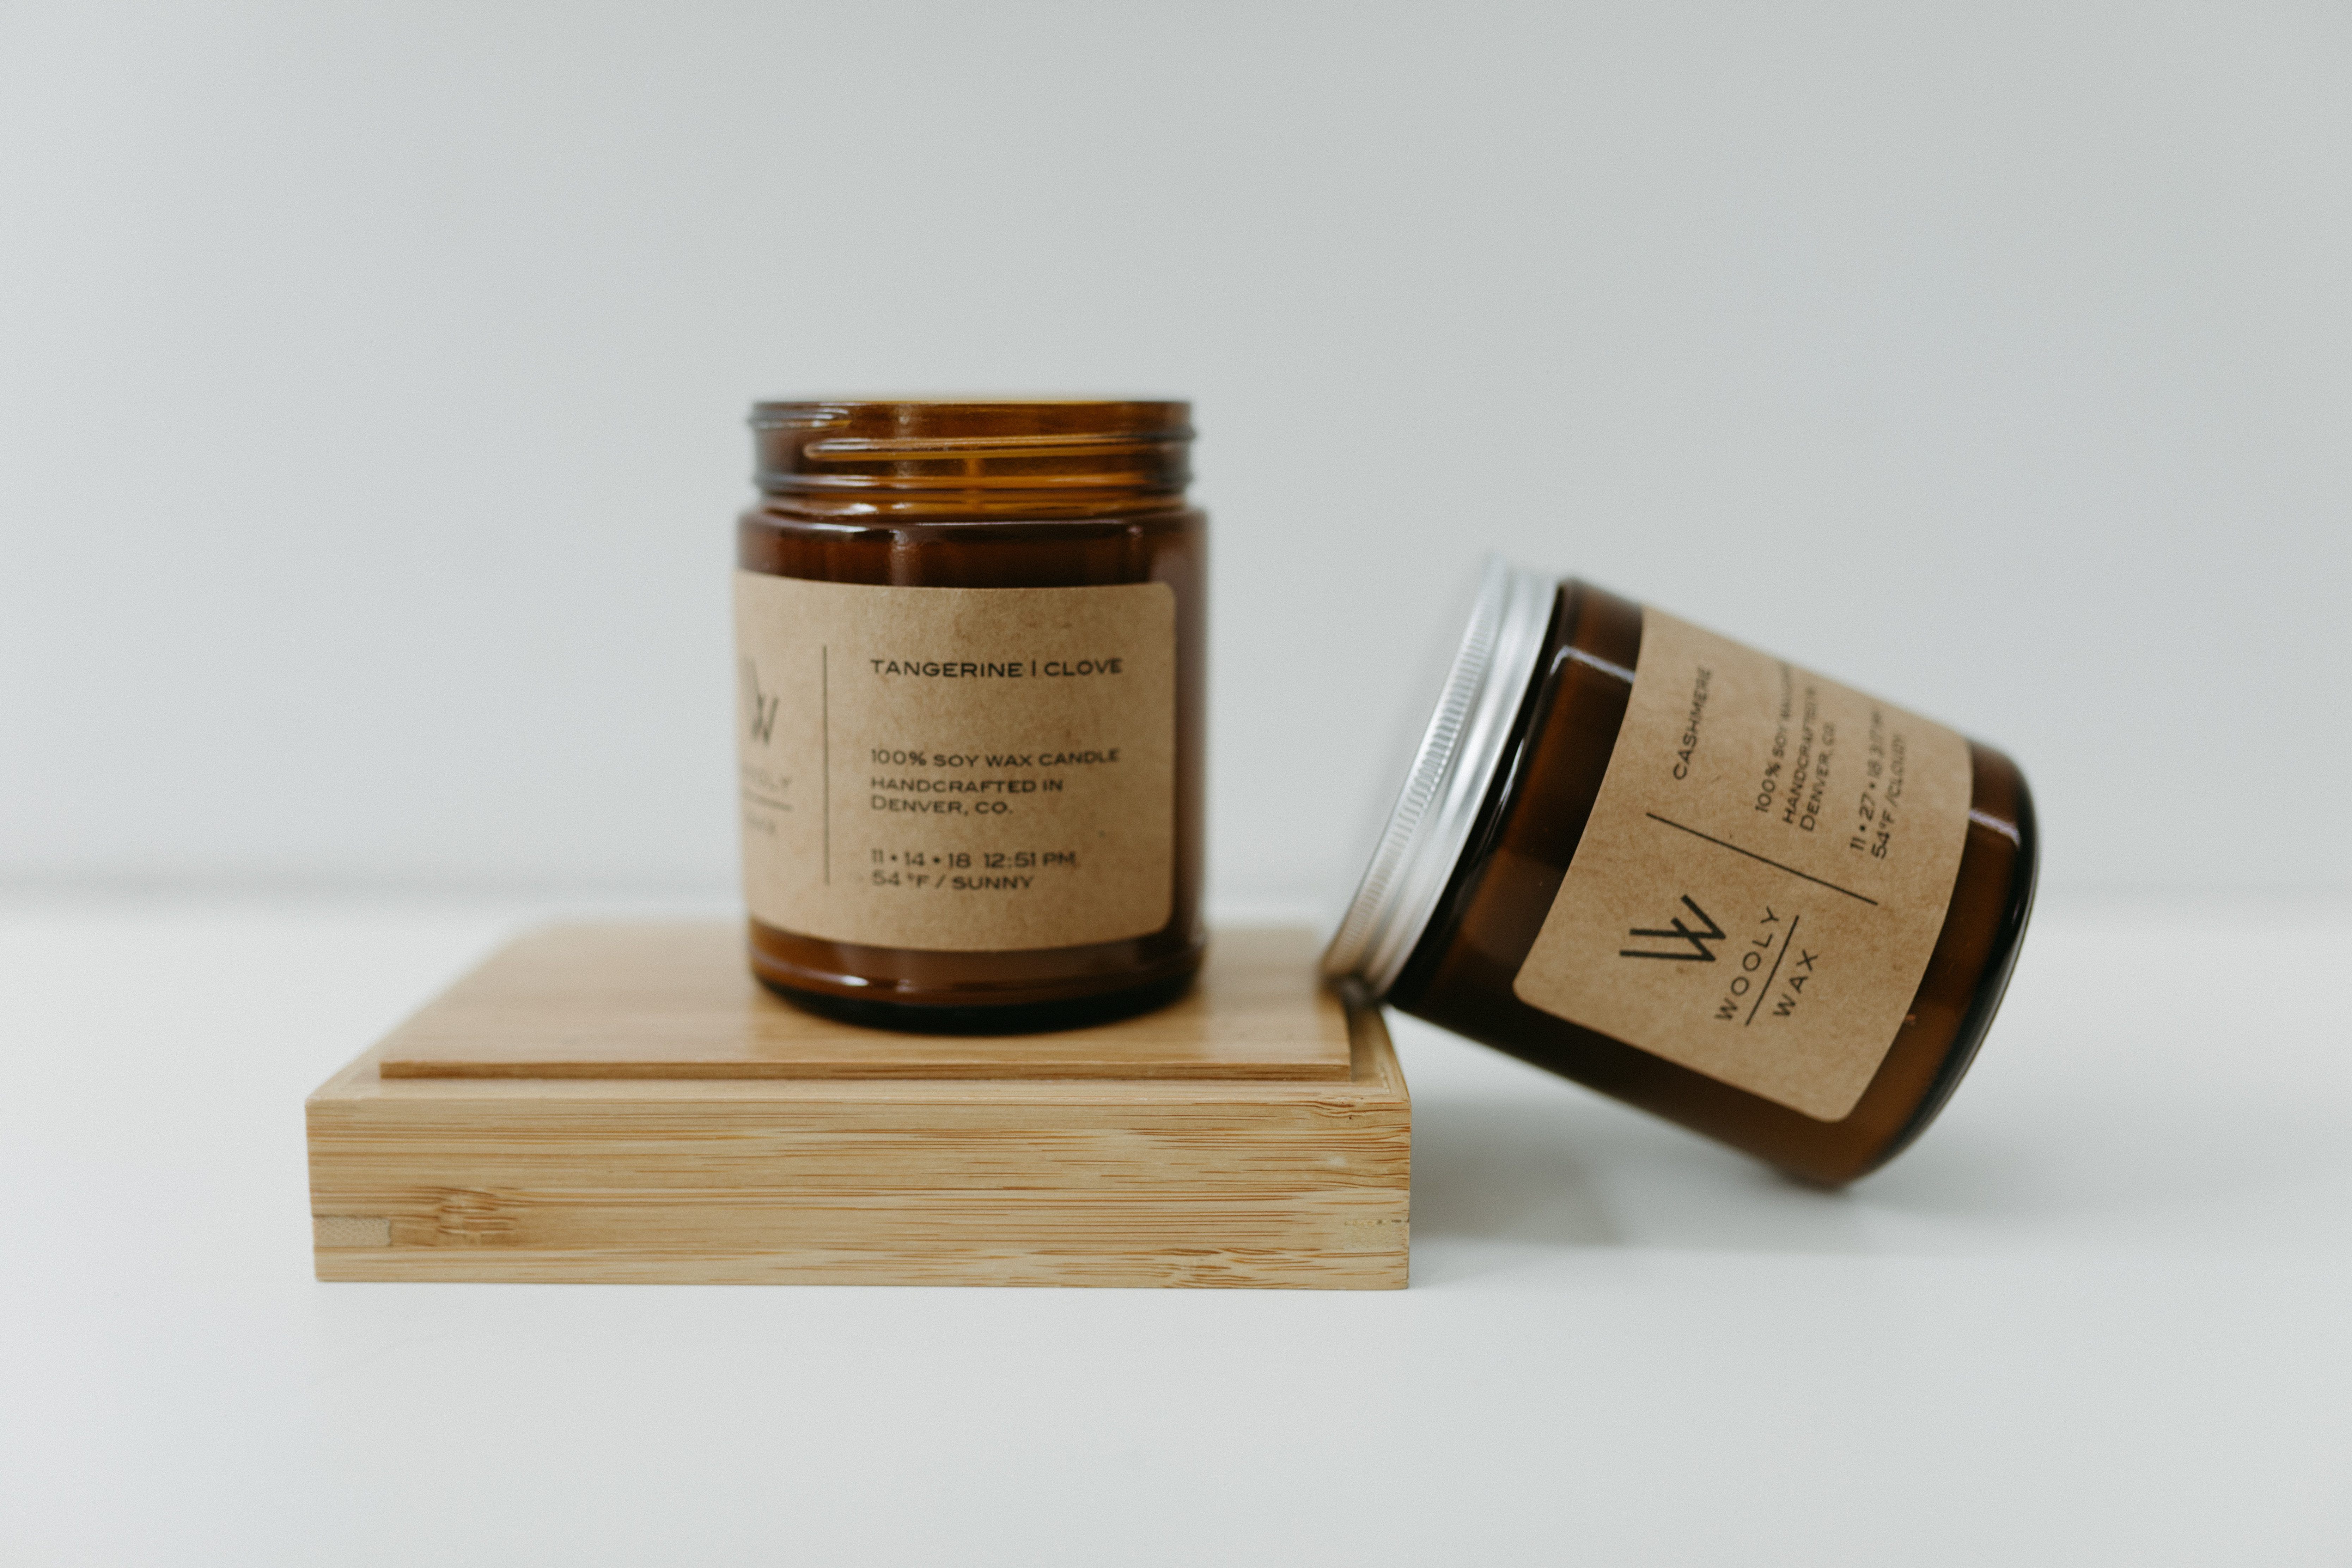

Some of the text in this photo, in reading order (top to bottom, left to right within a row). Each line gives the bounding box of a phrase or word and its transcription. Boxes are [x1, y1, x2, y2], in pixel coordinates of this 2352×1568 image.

[870, 659, 1023, 677] TANGERINE
[1044, 658, 1123, 676] CLOVE
[1673, 667, 1711, 780] CASHMERE
[871, 748, 1119, 767] 100% SOY WAX CANDLE
[1755, 763, 1781, 812] 100%
[1772, 722, 1788, 758] SOY
[1800, 722, 1835, 832] DENVER, CO
[871, 777, 1063, 793] HANDCRAFTED IN
[872, 795, 1013, 816] DENVER, CO.
[1850, 837, 1866, 851] 11
[1860, 793, 1876, 821] 27
[1872, 810, 1898, 860] 54°F
[872, 850, 883, 864] 11
[905, 852, 925, 867] 14
[949, 852, 970, 868] 18
[985, 853, 1036, 869] 12:51
[1043, 852, 1076, 867] PM
[872, 870, 900, 886] 54
[953, 876, 1034, 891] SUNNY
[1715, 906, 1779, 1020] WOOLY
[1773, 949, 1818, 1017] WAX
